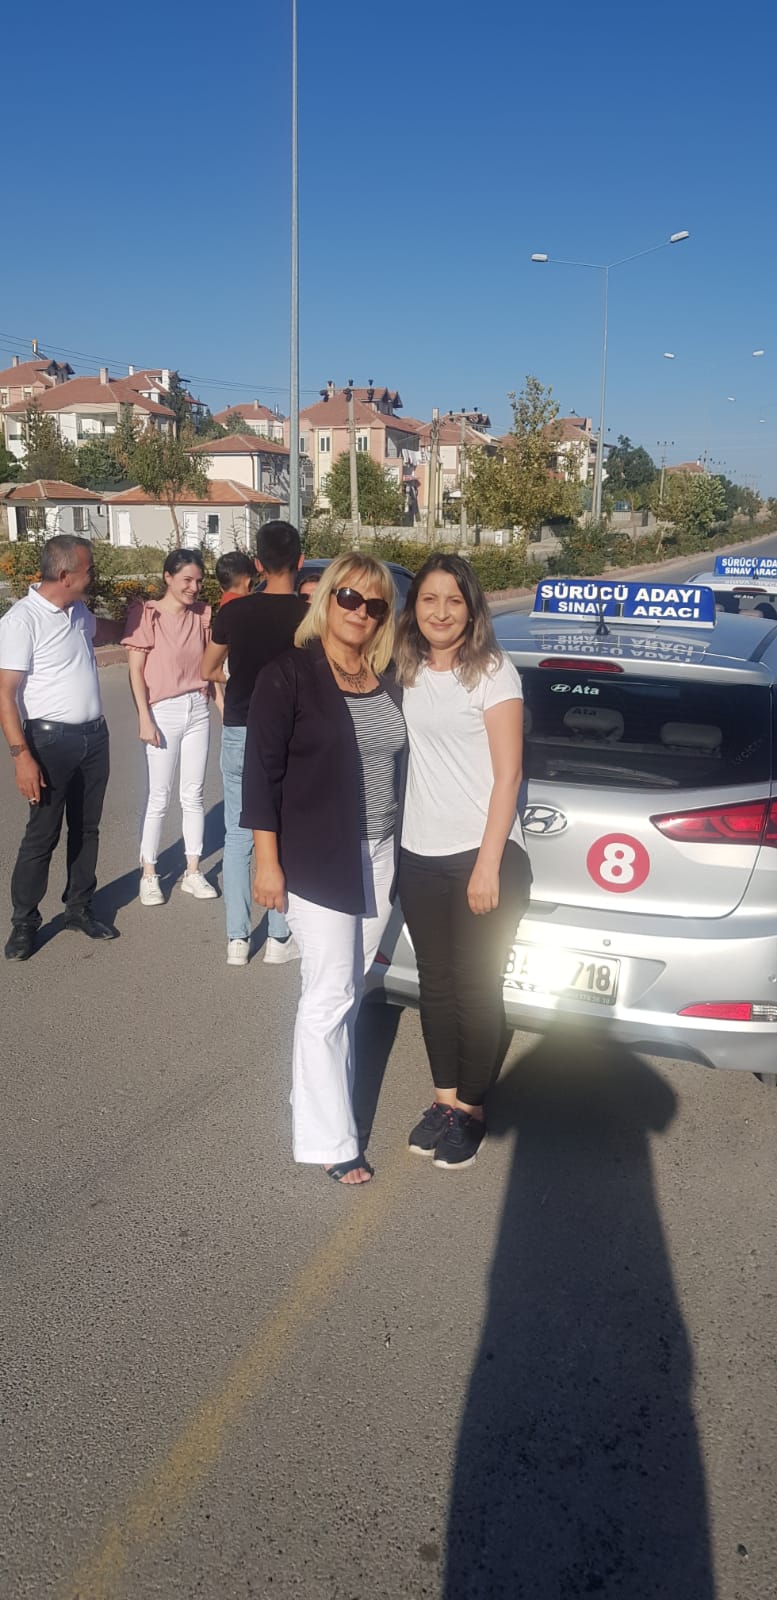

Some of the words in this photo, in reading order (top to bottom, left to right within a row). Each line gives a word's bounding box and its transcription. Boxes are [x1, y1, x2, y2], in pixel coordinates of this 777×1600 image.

[722, 557, 758, 568] SÜRÜCÜ
[725, 567, 751, 575] SINAV
[541, 583, 629, 601] SÜRÜCÜ
[634, 588, 701, 604] ADAYI
[558, 601, 608, 614] SINAV
[633, 605, 700, 619] ARACI
[571, 684, 600, 696] Ata
[599, 842, 636, 884] 8
